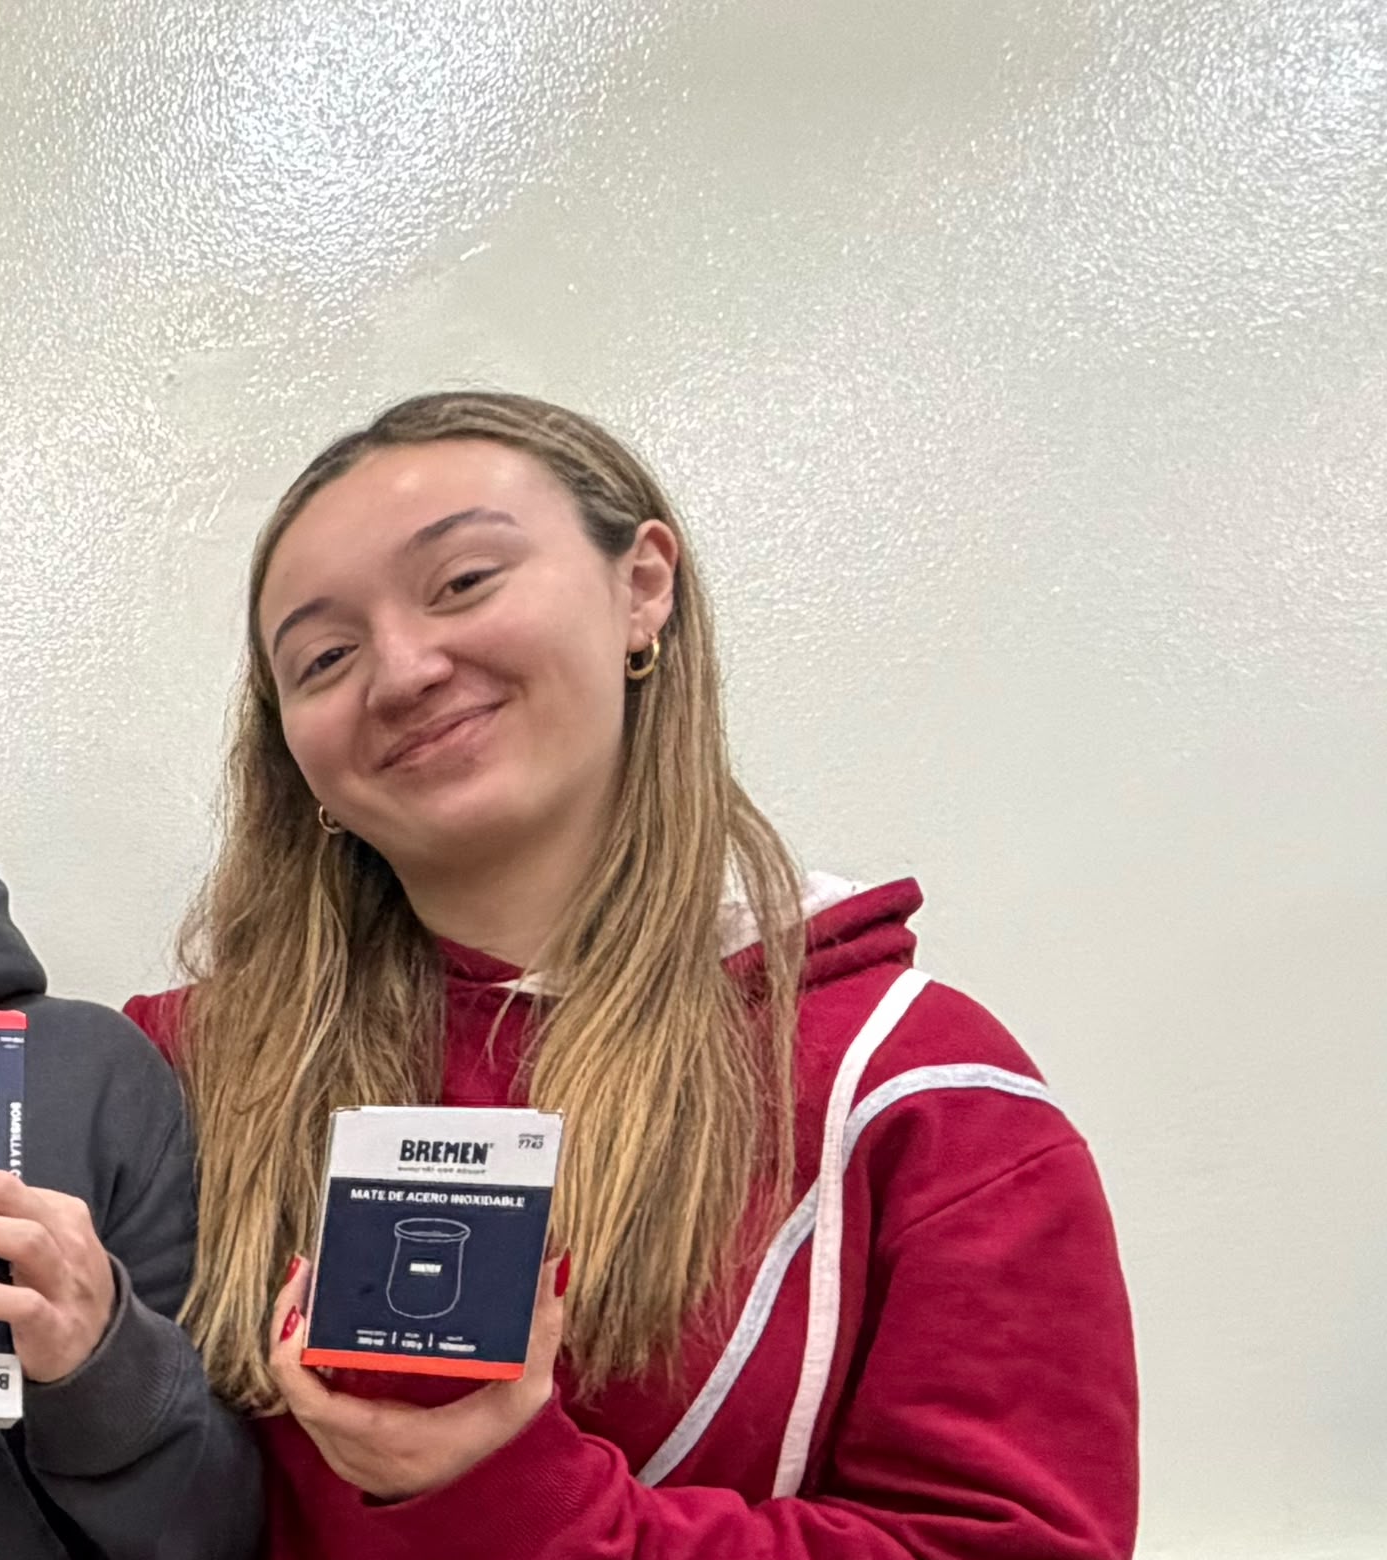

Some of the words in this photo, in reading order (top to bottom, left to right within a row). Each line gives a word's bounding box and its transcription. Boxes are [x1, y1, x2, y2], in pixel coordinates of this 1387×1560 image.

[399, 1139, 489, 1165] BREMEN
[350, 1188, 386, 1201] MATE
[388, 1190, 405, 1201] DE
[406, 1191, 448, 1204] ACERO
[450, 1193, 525, 1208] INOXIDABLE
